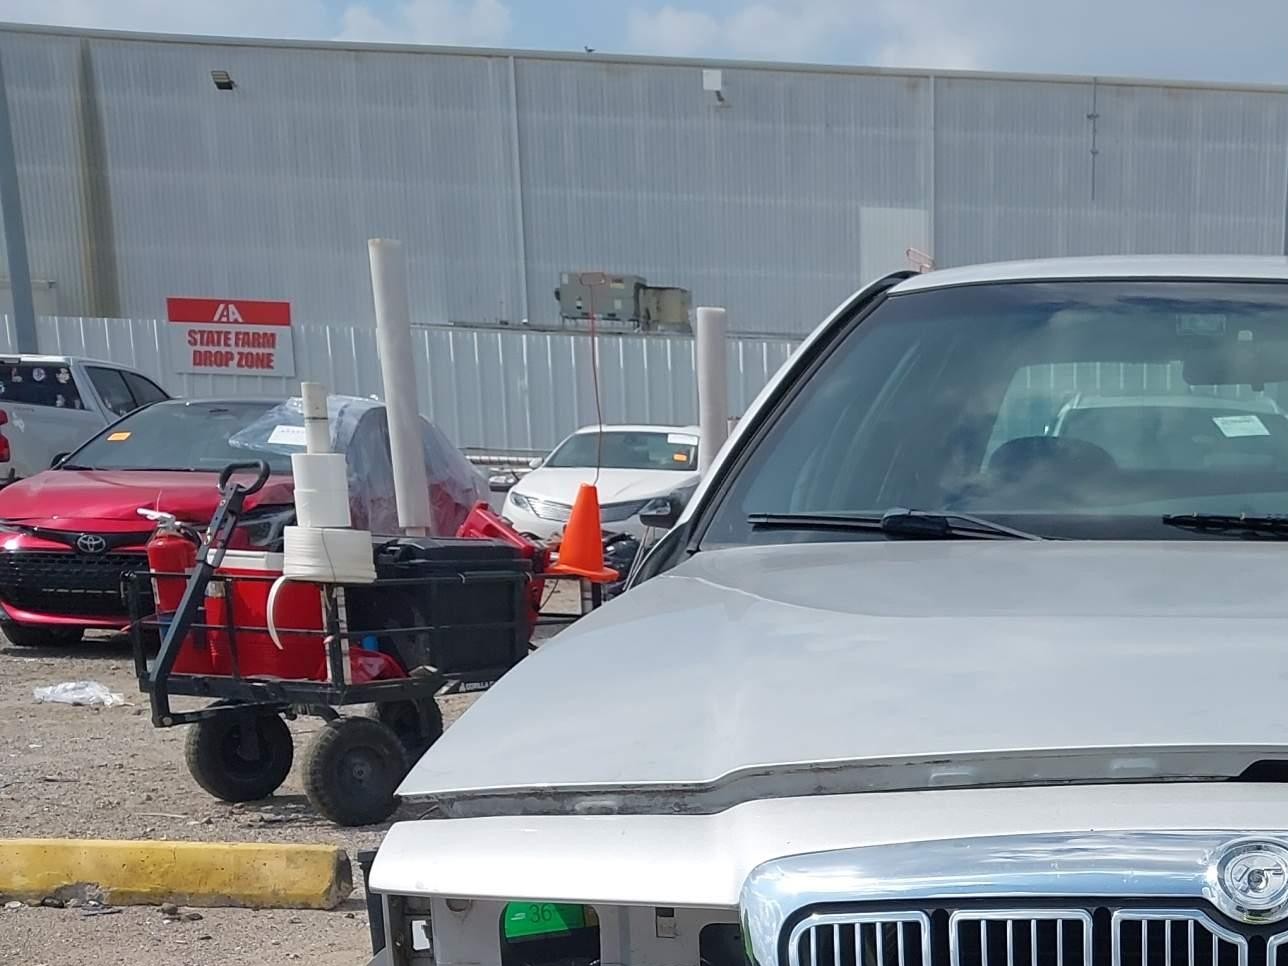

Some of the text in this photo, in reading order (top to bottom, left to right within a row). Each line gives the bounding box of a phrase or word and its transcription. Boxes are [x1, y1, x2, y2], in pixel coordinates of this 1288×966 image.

[187, 329, 276, 349] STATE FARM
[192, 350, 275, 369] DROP ZONE
